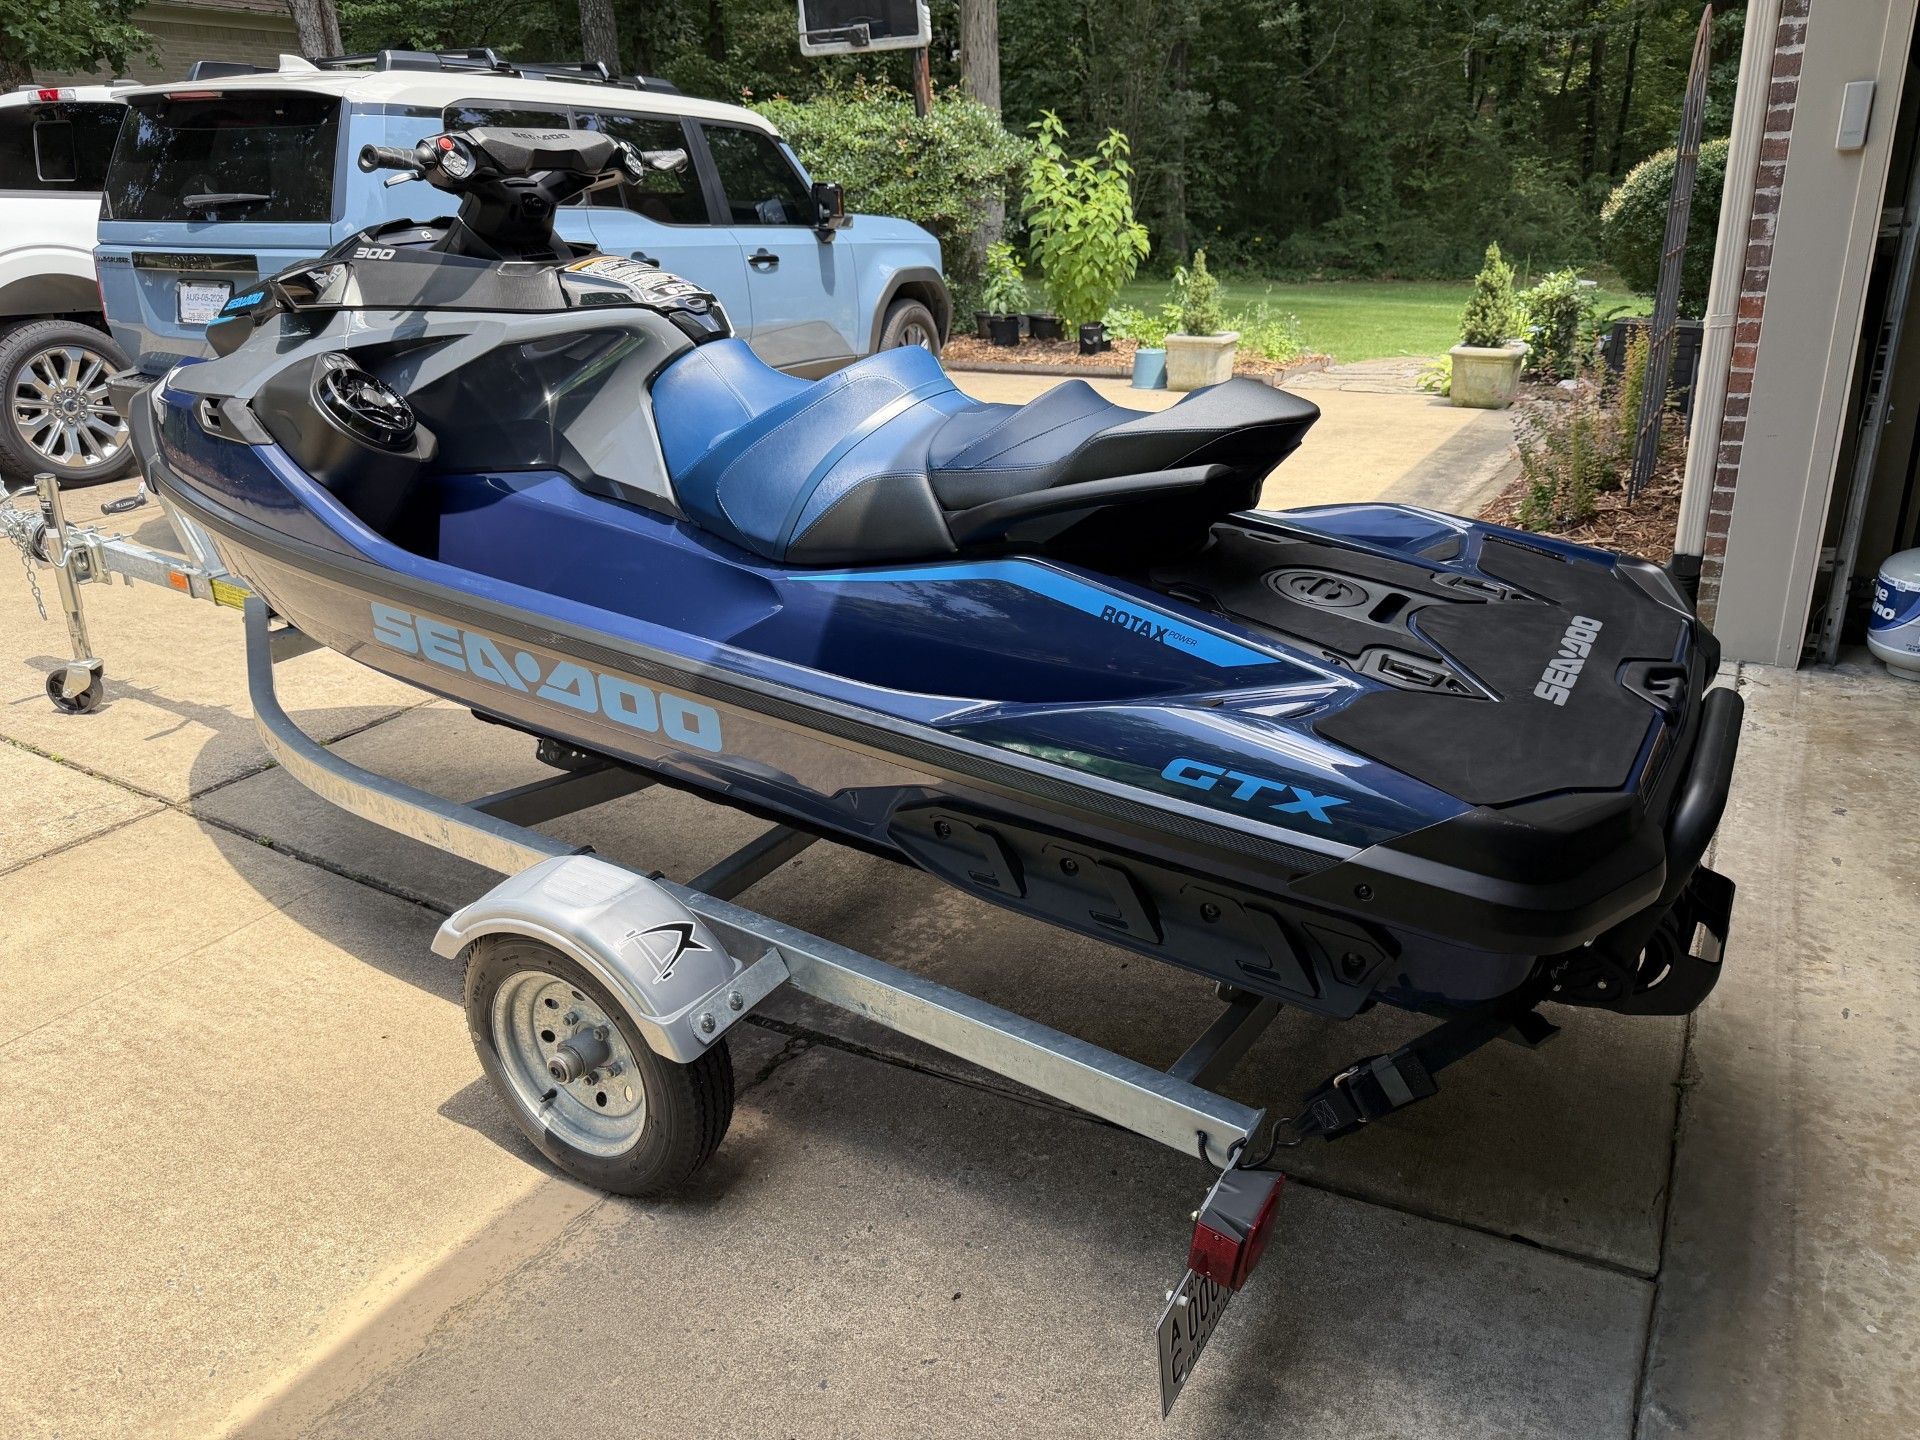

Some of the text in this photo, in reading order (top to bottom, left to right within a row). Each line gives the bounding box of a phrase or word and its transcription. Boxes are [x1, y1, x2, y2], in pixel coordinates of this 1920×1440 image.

[354, 247, 396, 260] 300
[1100, 604, 1198, 646] ROTAX POWER
[1161, 758, 1350, 824] GTX
